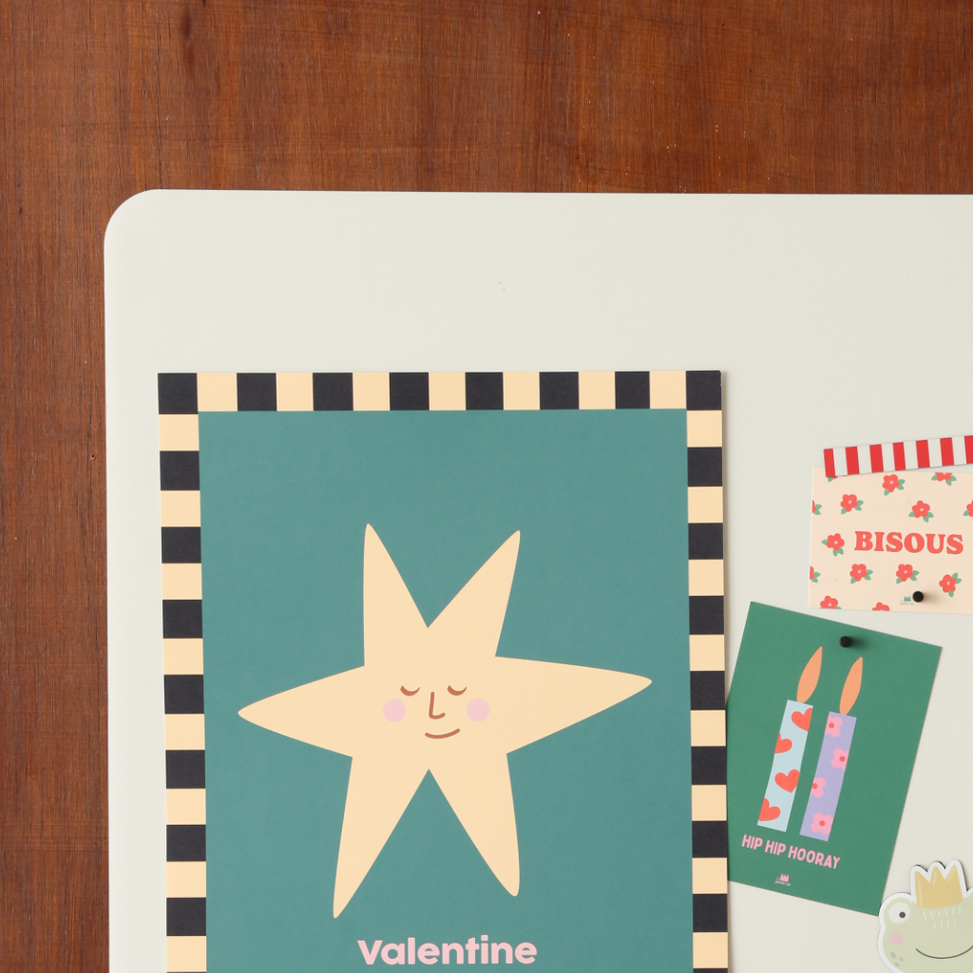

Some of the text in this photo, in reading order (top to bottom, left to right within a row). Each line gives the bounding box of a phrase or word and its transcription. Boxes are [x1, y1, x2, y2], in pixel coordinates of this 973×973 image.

[854, 531, 964, 555] BISOUS
[741, 834, 841, 869] HIP HIP HOORAY
[357, 934, 538, 965] Valentine
